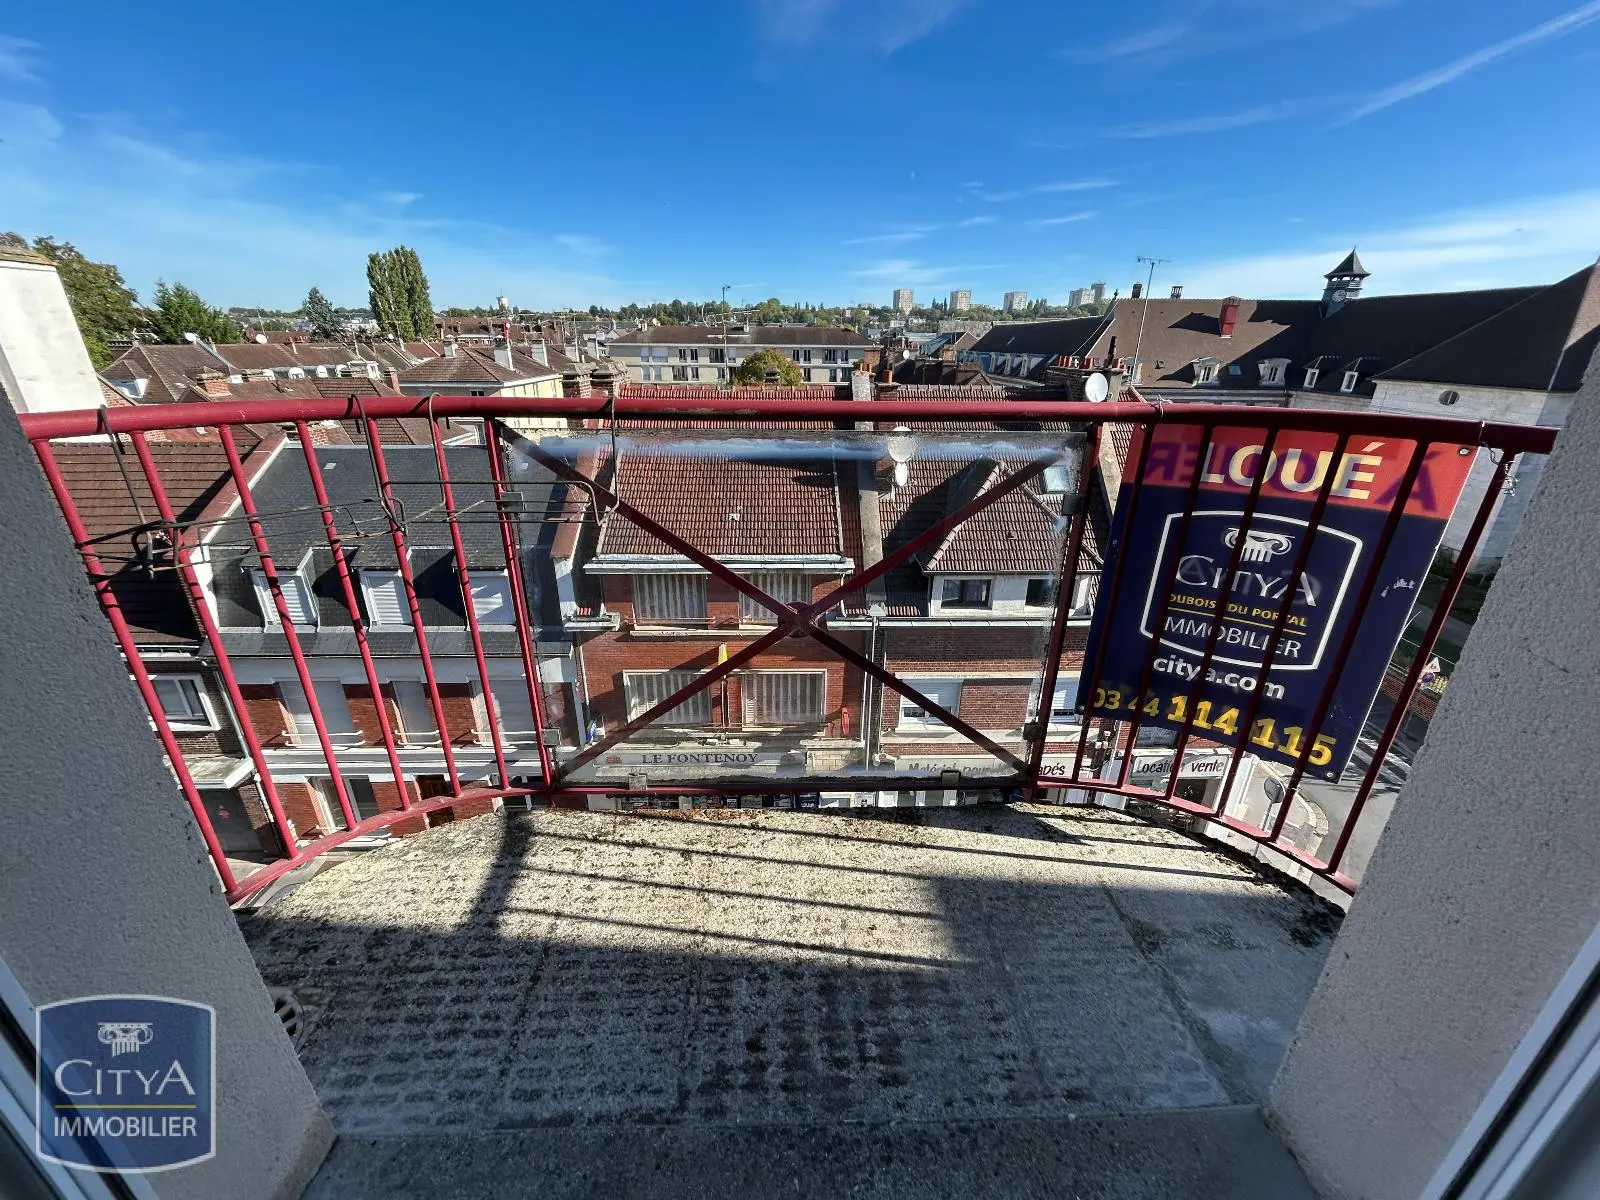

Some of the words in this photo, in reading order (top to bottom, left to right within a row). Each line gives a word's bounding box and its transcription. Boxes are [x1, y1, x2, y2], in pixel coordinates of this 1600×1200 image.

[1200, 441, 1384, 500] LOUÉ
[1176, 554, 1316, 607] CITYA
[1227, 603, 1249, 615] DU
[1161, 616, 1302, 658] MMOBILIER
[1153, 654, 1285, 700] citya.com
[1167, 695, 1240, 735] 114
[1251, 717, 1337, 767] 115
[642, 754, 663, 764] LE
[667, 752, 759, 764] FONTENOY
[1191, 757, 1224, 773] vente
